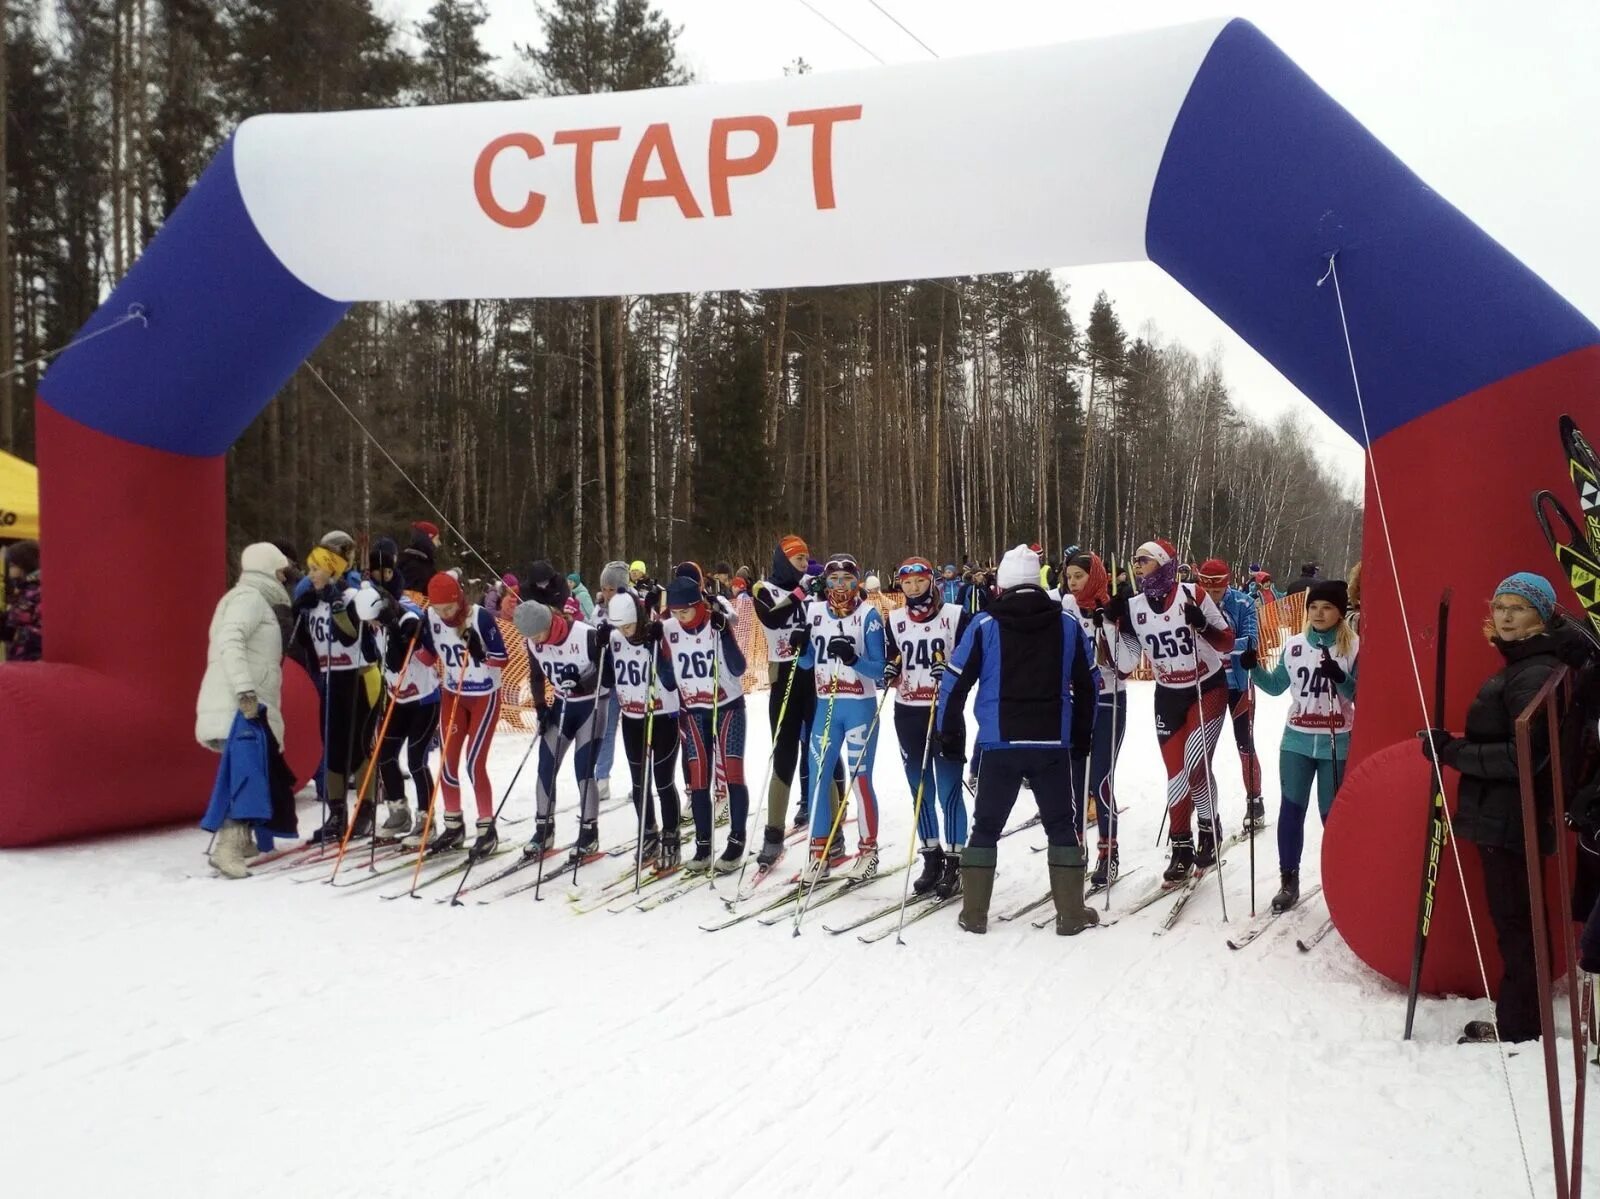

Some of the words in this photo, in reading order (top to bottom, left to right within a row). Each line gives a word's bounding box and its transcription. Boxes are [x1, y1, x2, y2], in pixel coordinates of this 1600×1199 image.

[473, 104, 863, 229] СТАРТ
[678, 650, 718, 679] 262
[1145, 626, 1193, 660] 253
[1422, 818, 1441, 937] FISCHER
